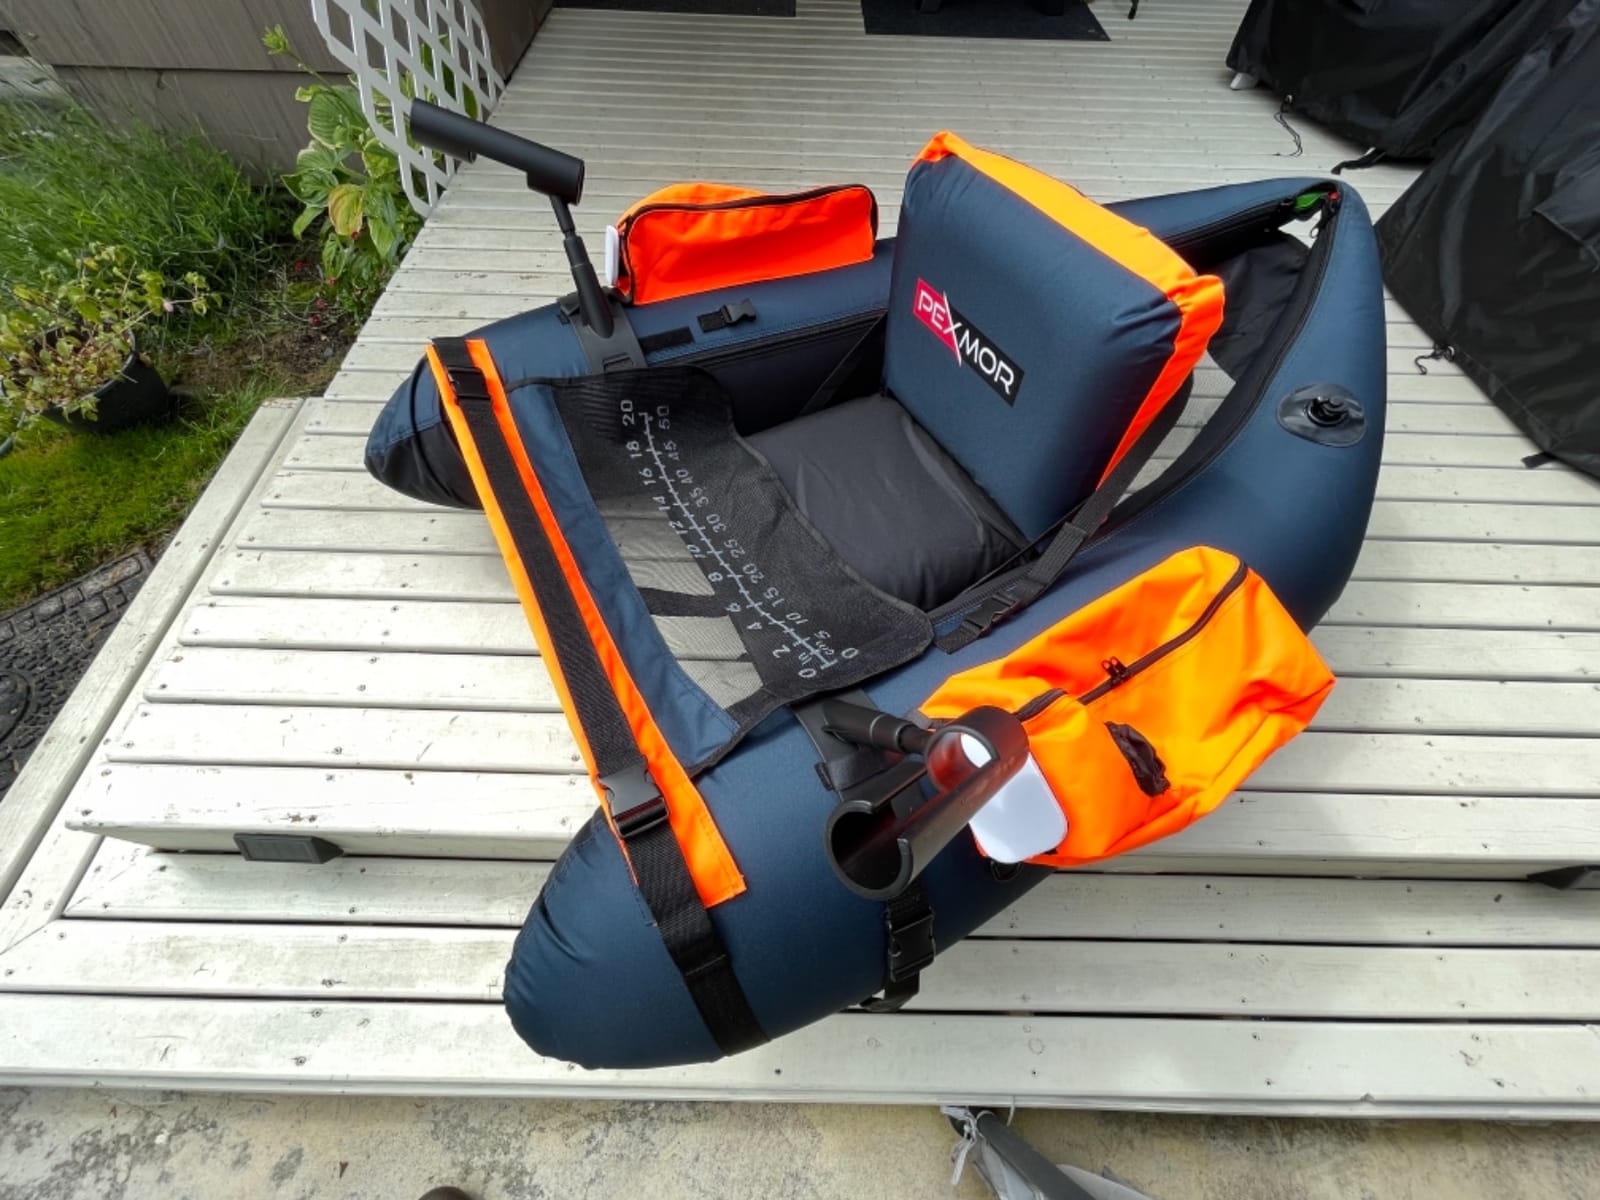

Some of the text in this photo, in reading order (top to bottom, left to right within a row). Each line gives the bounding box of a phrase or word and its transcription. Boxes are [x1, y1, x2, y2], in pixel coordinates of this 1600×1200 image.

[917, 289, 1015, 395] PEXMOR
[620, 399, 635, 427] 20
[657, 405, 671, 430] 50
[626, 441, 642, 459] 18
[663, 440, 680, 461] 45
[638, 467, 658, 485] 16
[676, 469, 694, 484] 40
[652, 496, 671, 511] 14
[689, 487, 709, 508] 35
[668, 521, 688, 534] 12
[706, 514, 726, 533] 30
[687, 545, 706, 558] 10
[723, 539, 746, 558] 25
[708, 572, 723, 583] 8
[742, 563, 765, 584] 20
[763, 587, 785, 607] 15
[725, 602, 741, 613] 6
[747, 622, 762, 630] 4
[786, 612, 808, 625] 10
[772, 644, 791, 658] 2
